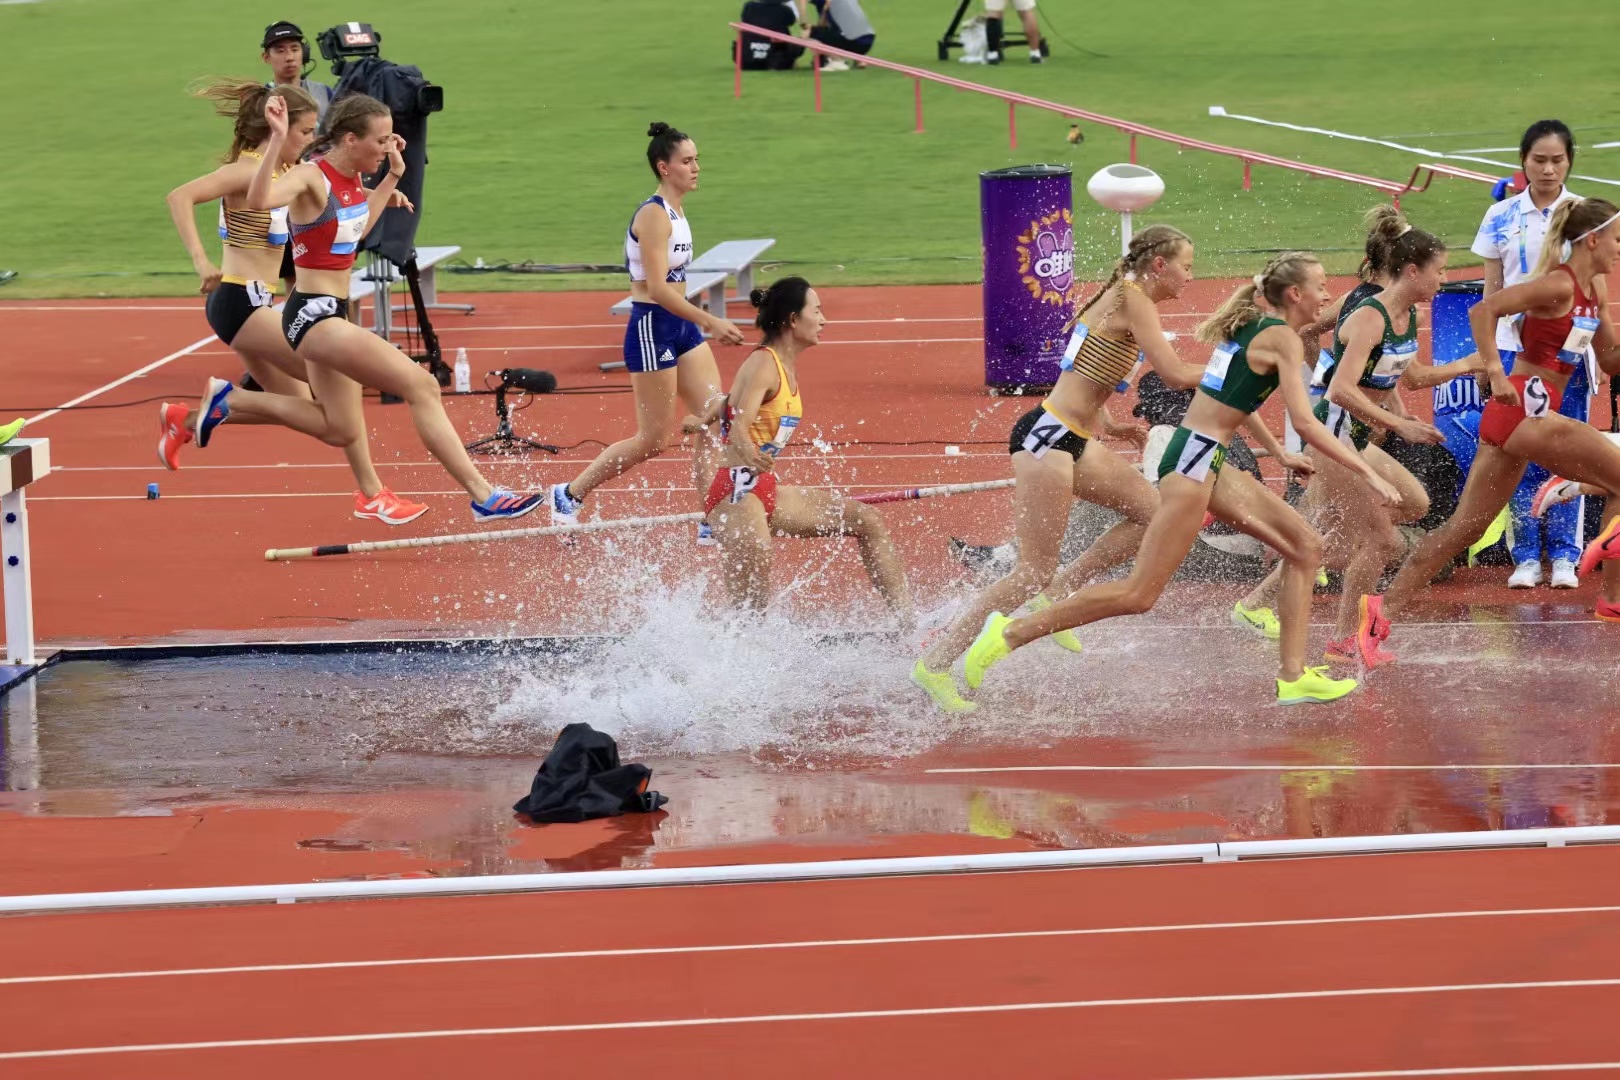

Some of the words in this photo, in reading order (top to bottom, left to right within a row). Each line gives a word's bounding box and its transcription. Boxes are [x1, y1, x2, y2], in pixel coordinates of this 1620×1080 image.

[346, 34, 370, 44] CMG
[1031, 424, 1062, 453] 4
[1182, 433, 1217, 475] 7
